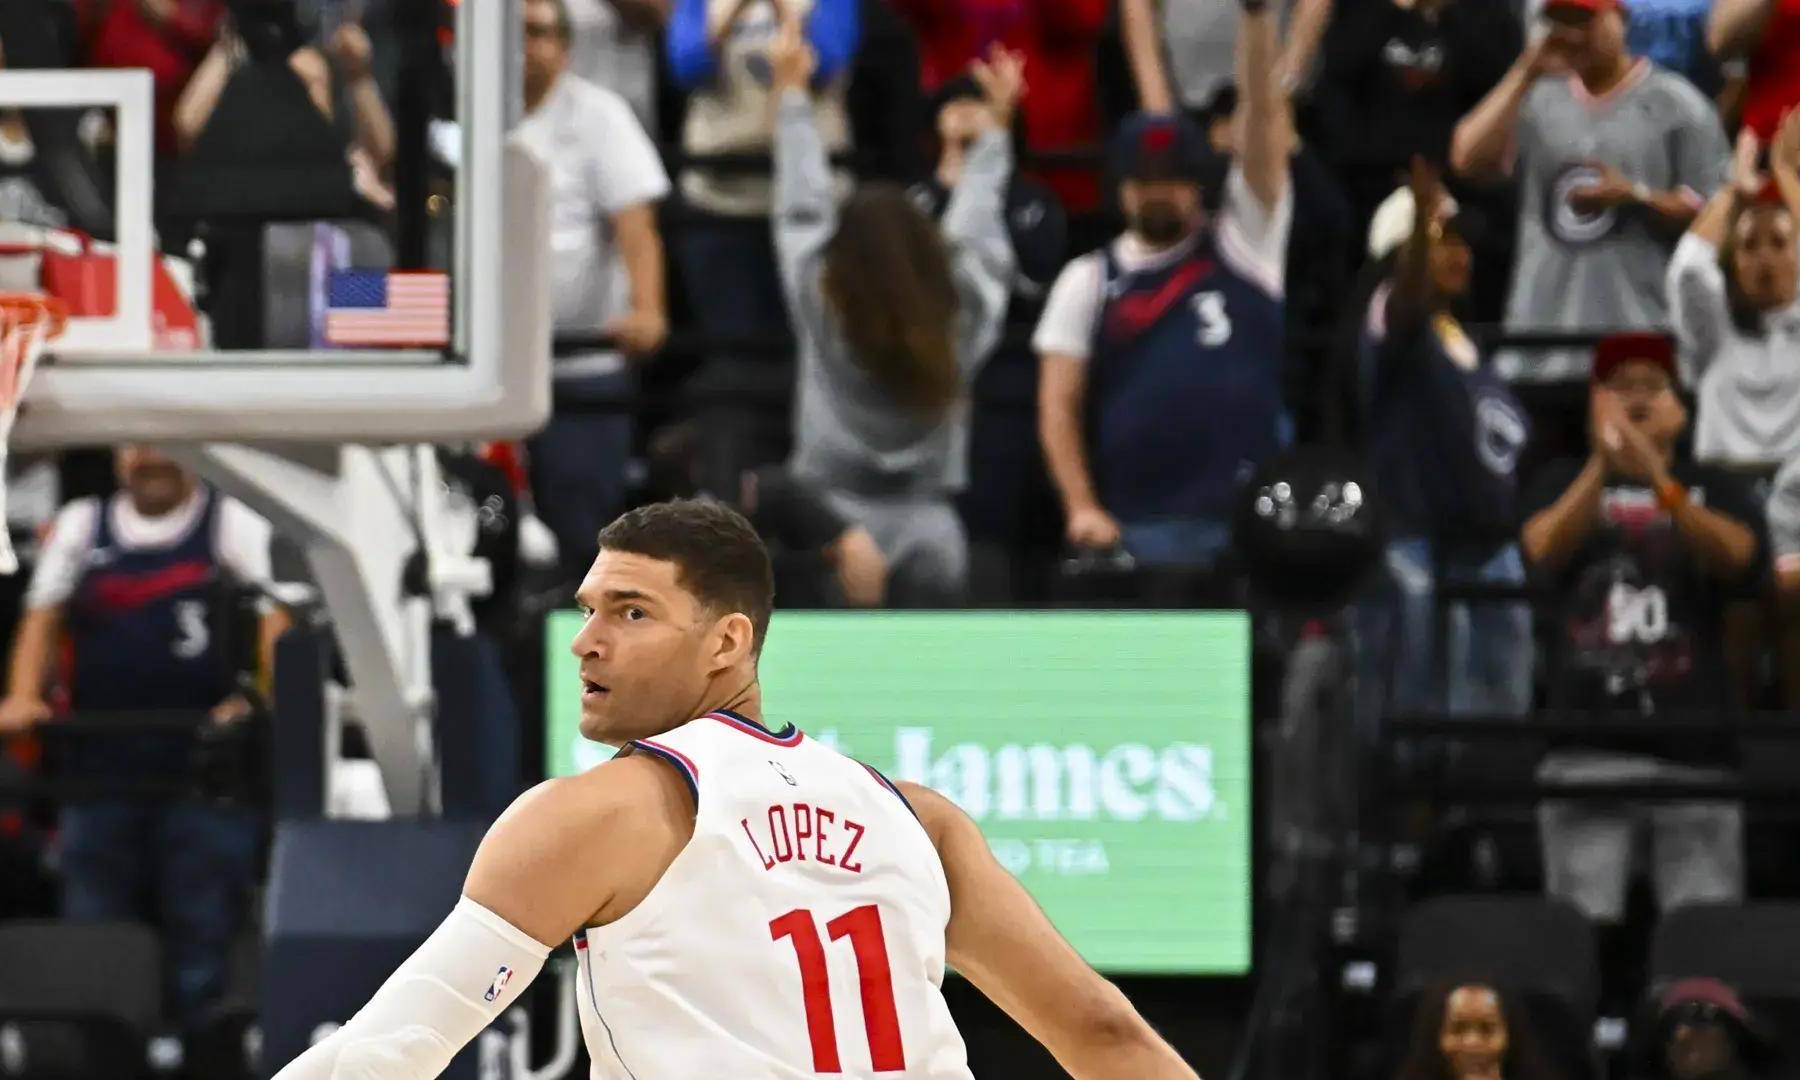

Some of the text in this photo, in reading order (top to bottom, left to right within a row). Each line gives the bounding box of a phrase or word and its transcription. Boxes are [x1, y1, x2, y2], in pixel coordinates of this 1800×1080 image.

[741, 803, 865, 873] LOPEZ
[1035, 840, 1110, 875] TEA
[769, 904, 906, 1073] 11
